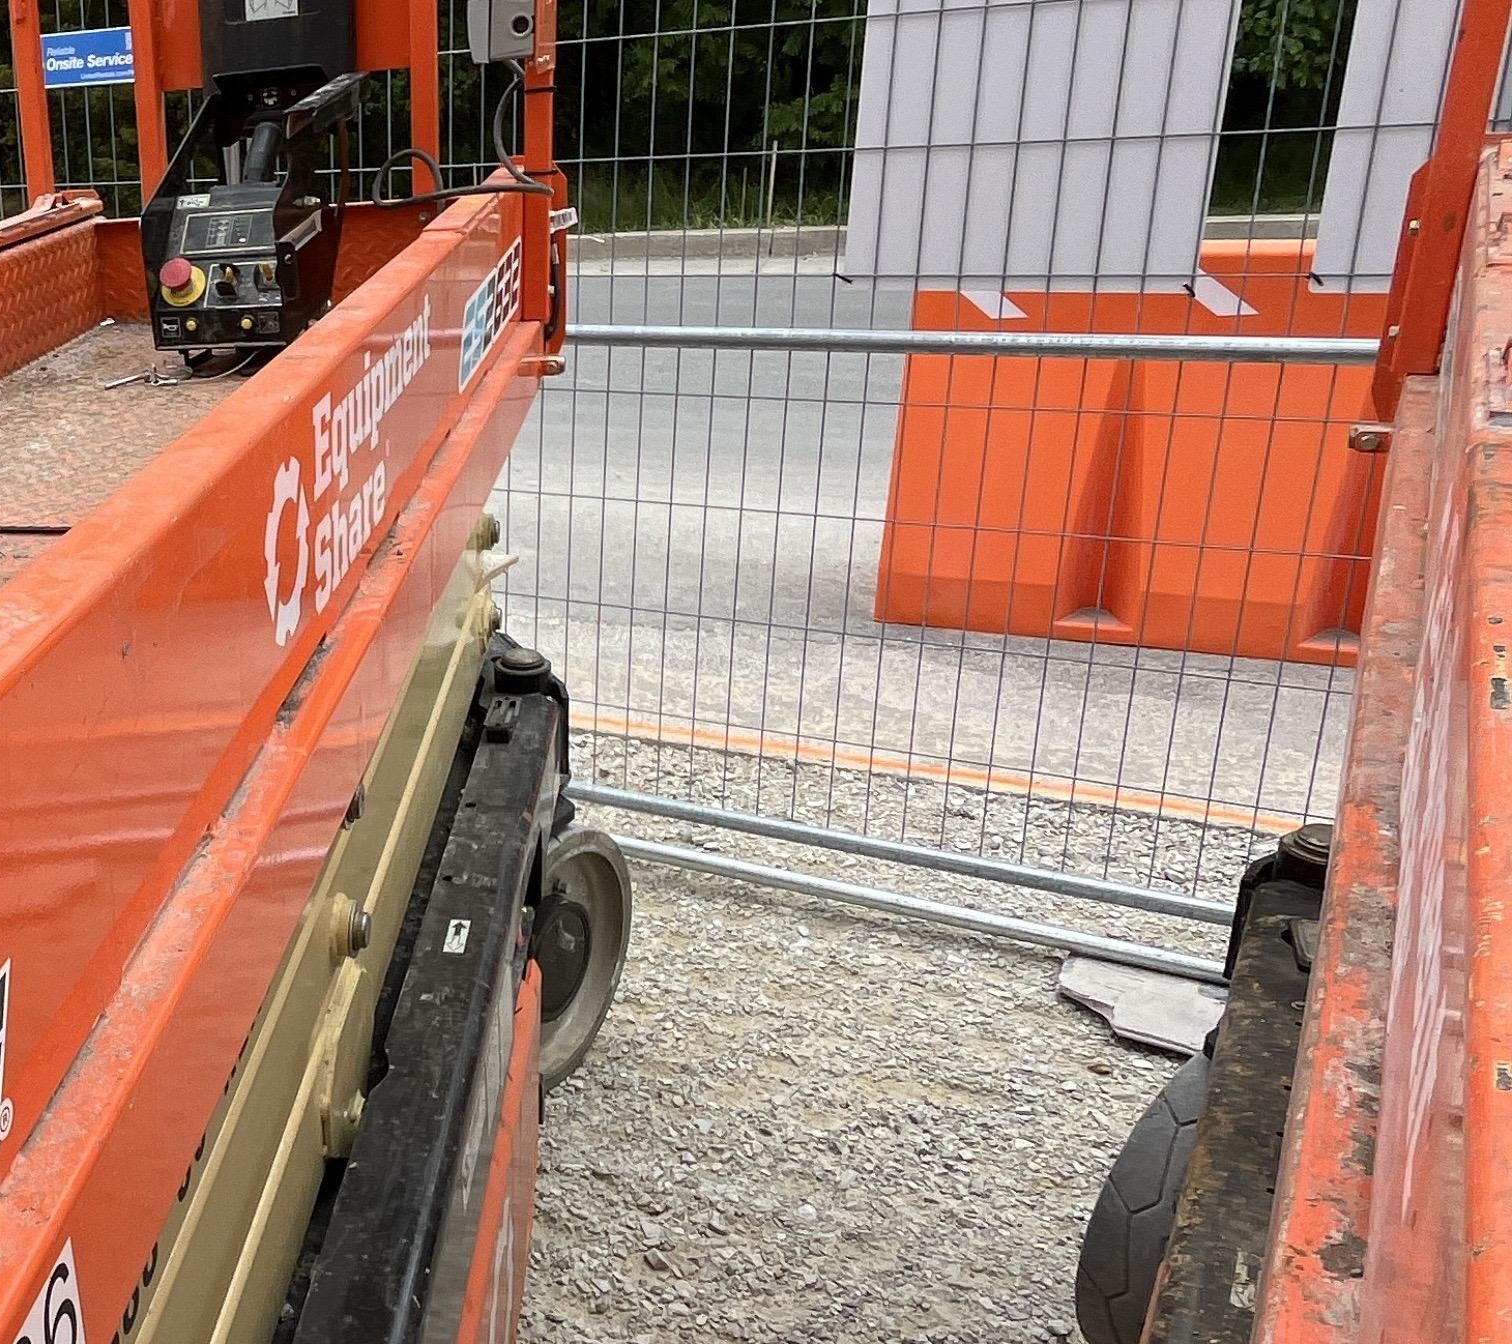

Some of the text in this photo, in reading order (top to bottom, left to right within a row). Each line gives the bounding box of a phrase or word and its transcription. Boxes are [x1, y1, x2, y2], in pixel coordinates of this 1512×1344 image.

[47, 52, 134, 71] Onsite Service
[312, 294, 431, 503] Equipment
[313, 458, 388, 616] Share
